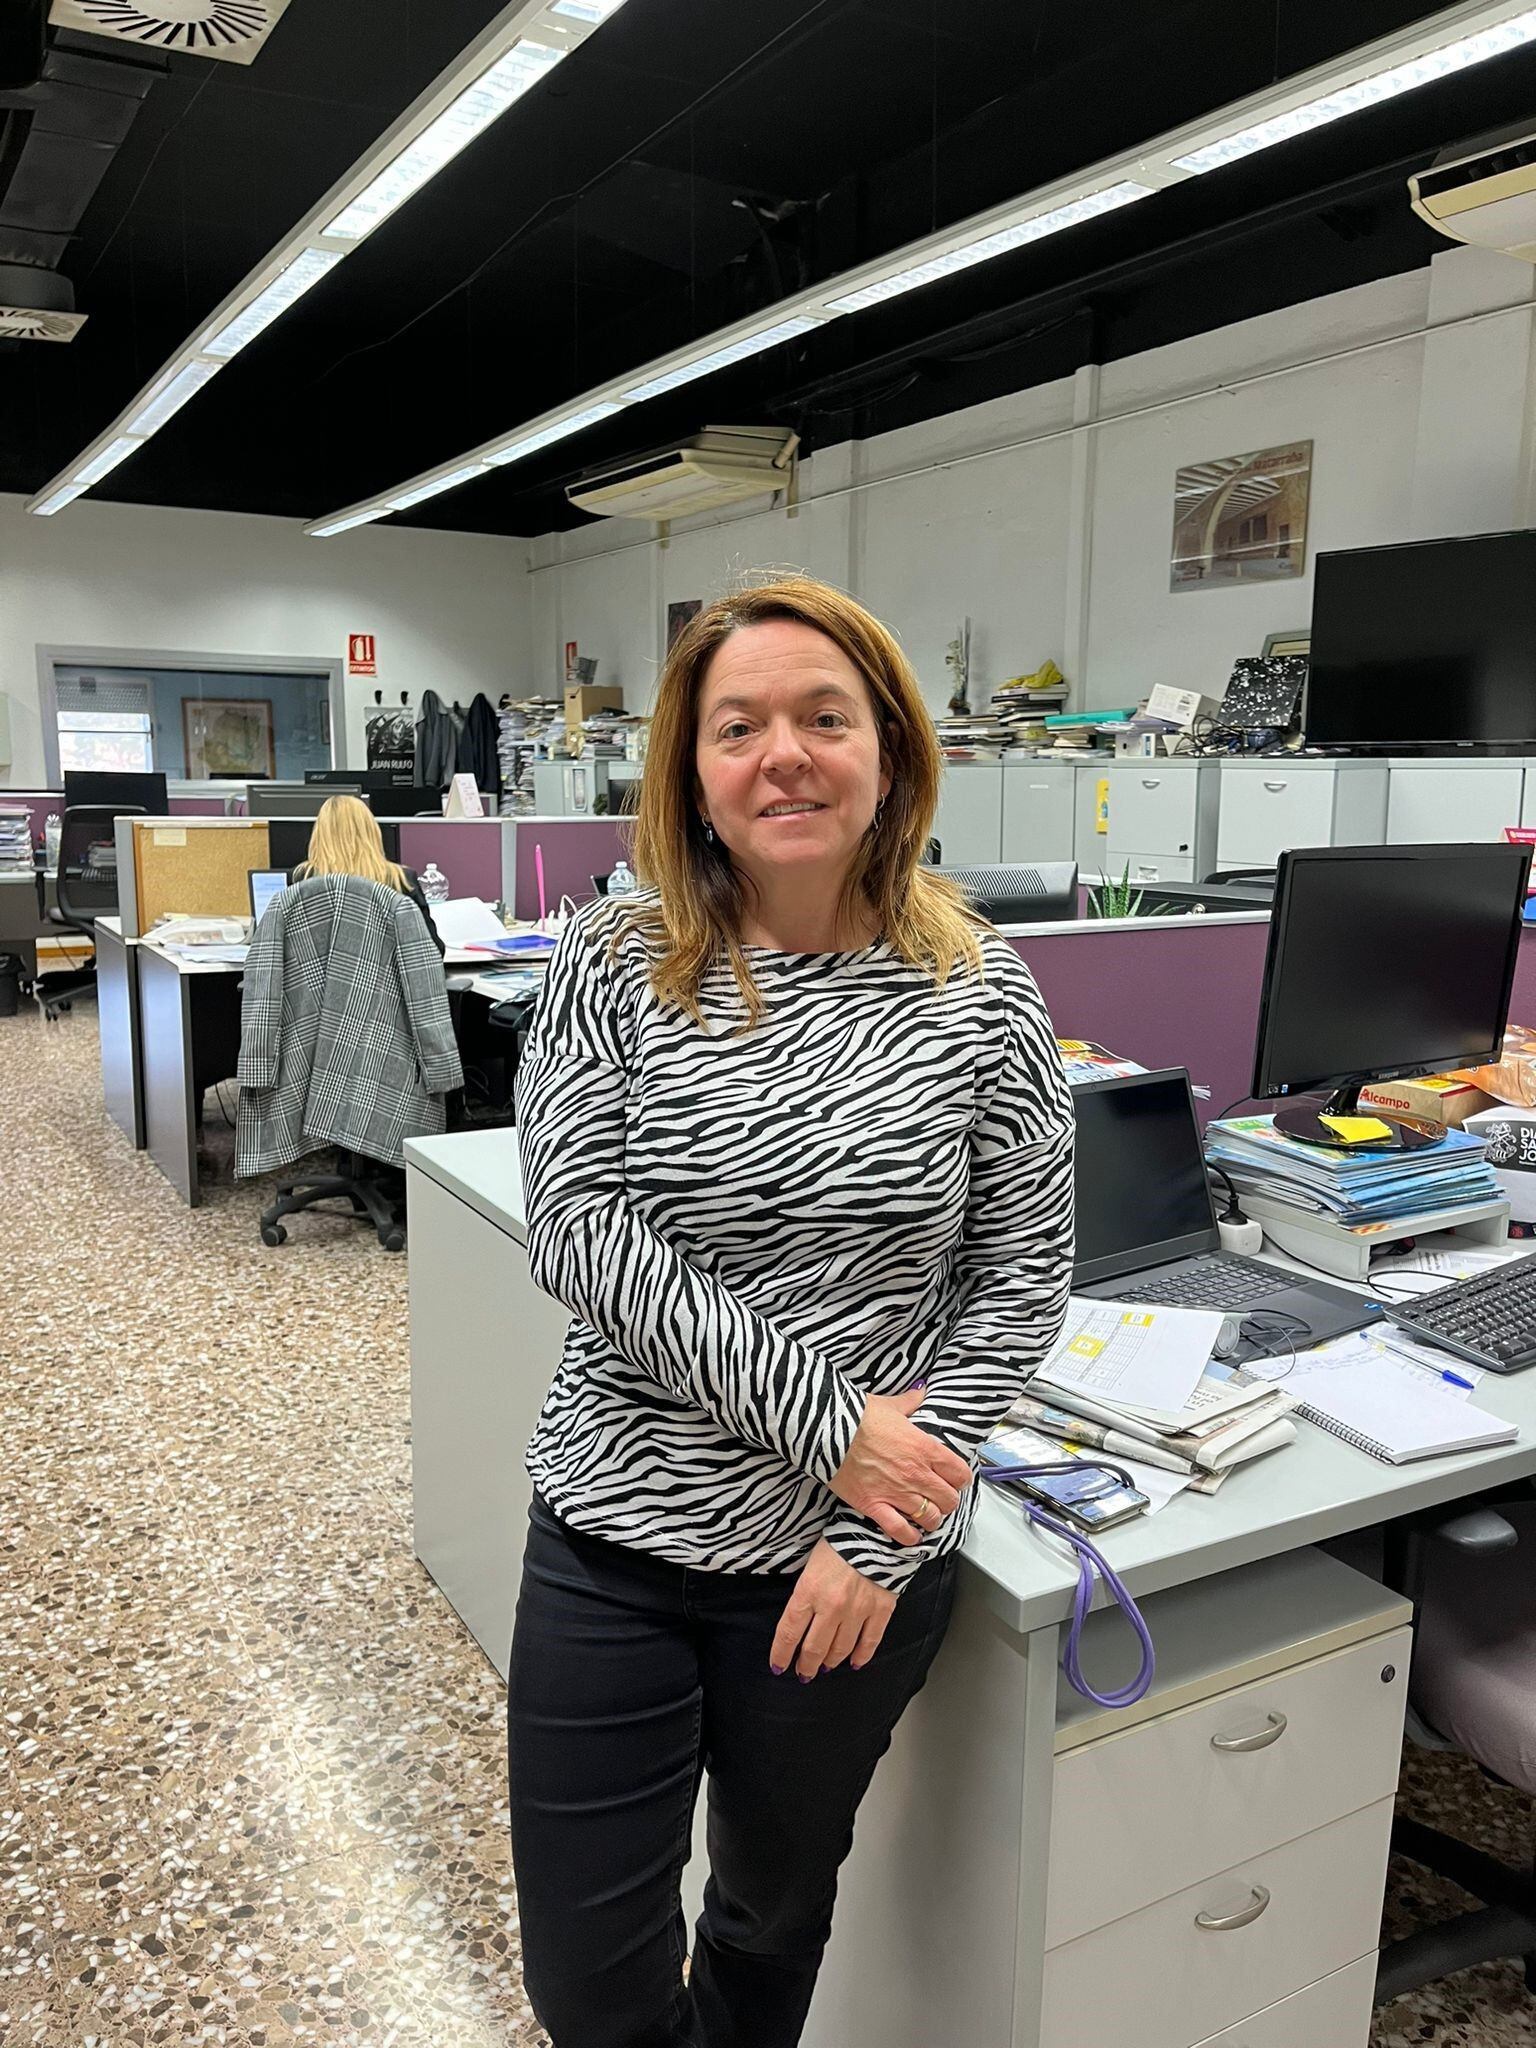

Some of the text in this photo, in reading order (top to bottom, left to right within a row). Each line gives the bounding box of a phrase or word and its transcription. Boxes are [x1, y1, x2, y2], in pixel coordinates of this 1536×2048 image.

[371, 760, 390, 769] JUAN
[1360, 1088, 1410, 1109] Alcampo
[1520, 1127, 1536, 1139] DI
